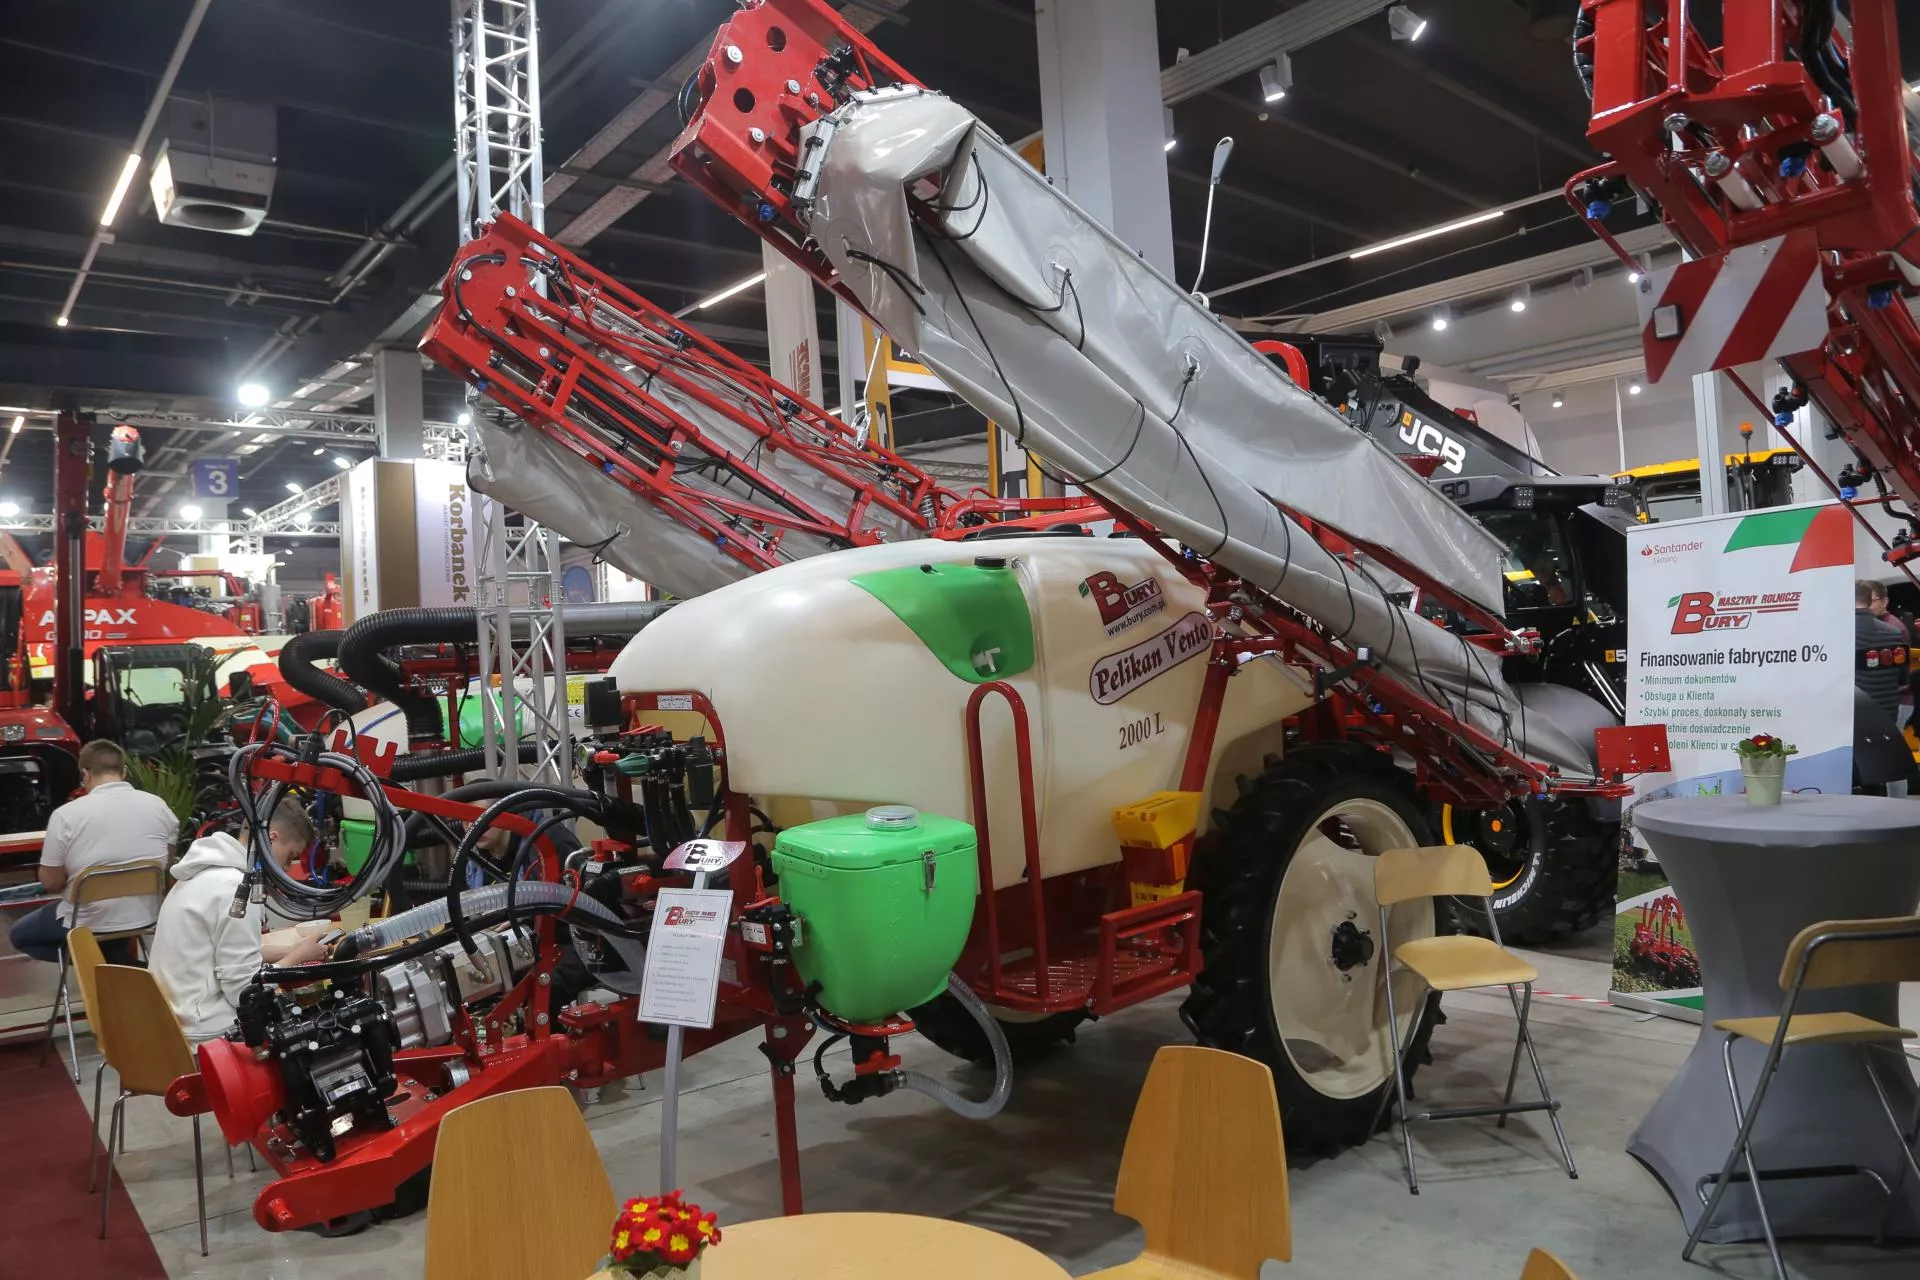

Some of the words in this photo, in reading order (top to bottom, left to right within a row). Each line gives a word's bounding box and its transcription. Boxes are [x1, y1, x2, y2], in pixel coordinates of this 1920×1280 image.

[1399, 418, 1466, 474] JCB
[208, 470, 228, 494] 3
[449, 484, 470, 602] Korbanek
[1654, 541, 1704, 554] Santander
[1085, 571, 1155, 626] BURY
[1718, 595, 1758, 606] MASZYNY
[1761, 592, 1802, 603] ROLNICZE
[1107, 598, 1166, 636] www.bury.com.pl
[1671, 592, 1749, 634] BURY
[1095, 648, 1163, 699] Pelikan
[1164, 622, 1209, 659] Vento
[1640, 650, 1725, 667] Finansowanie
[1729, 648, 1797, 667] fabryczne
[1801, 645, 1828, 663] 0%
[1645, 675, 1682, 685] Minimum
[1684, 673, 1737, 685] dokumentów
[1644, 691, 1677, 702] Obsługa
[1686, 691, 1715, 700] Klienta
[1643, 707, 1669, 718] Szybki
[1703, 707, 1747, 719] doskonały
[1750, 707, 1782, 718] serwis
[1119, 717, 1151, 750] 2000
[1154, 712, 1165, 734] L
[1689, 724, 1751, 734] doświadczenie
[1691, 740, 1718, 750] Klienci
[1492, 866, 1537, 910] MICHELIN
